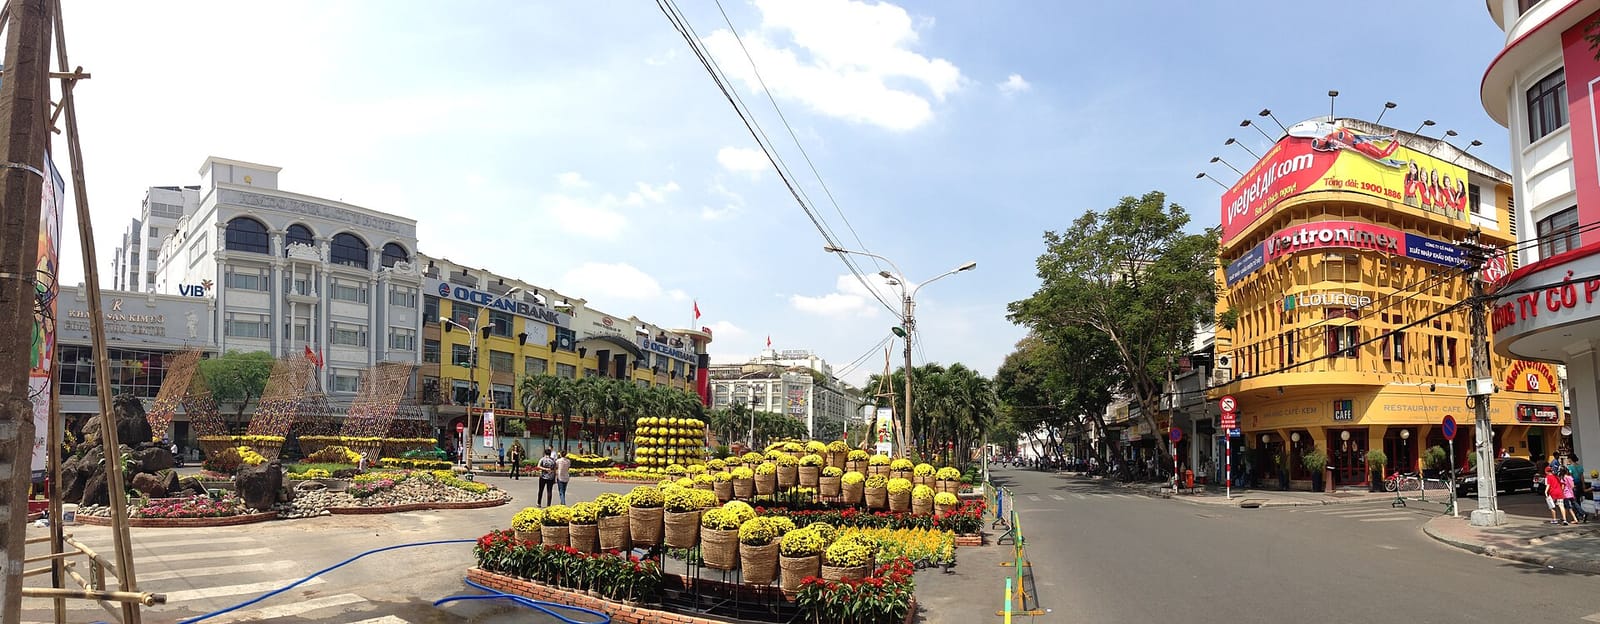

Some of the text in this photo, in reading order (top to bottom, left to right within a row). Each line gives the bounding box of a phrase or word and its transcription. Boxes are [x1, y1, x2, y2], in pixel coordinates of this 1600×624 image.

[1324, 176, 1401, 200] Tổng đài: 1900 1886
[1267, 227, 1398, 255] Viettronimex
[179, 284, 204, 297] VIB
[1300, 292, 1371, 310] Lounge
[1517, 291, 1540, 320] TY
[1546, 269, 1577, 312] CỔ
[453, 287, 560, 325] OCEANBANK
[1384, 404, 1438, 413] RESTAURANT
